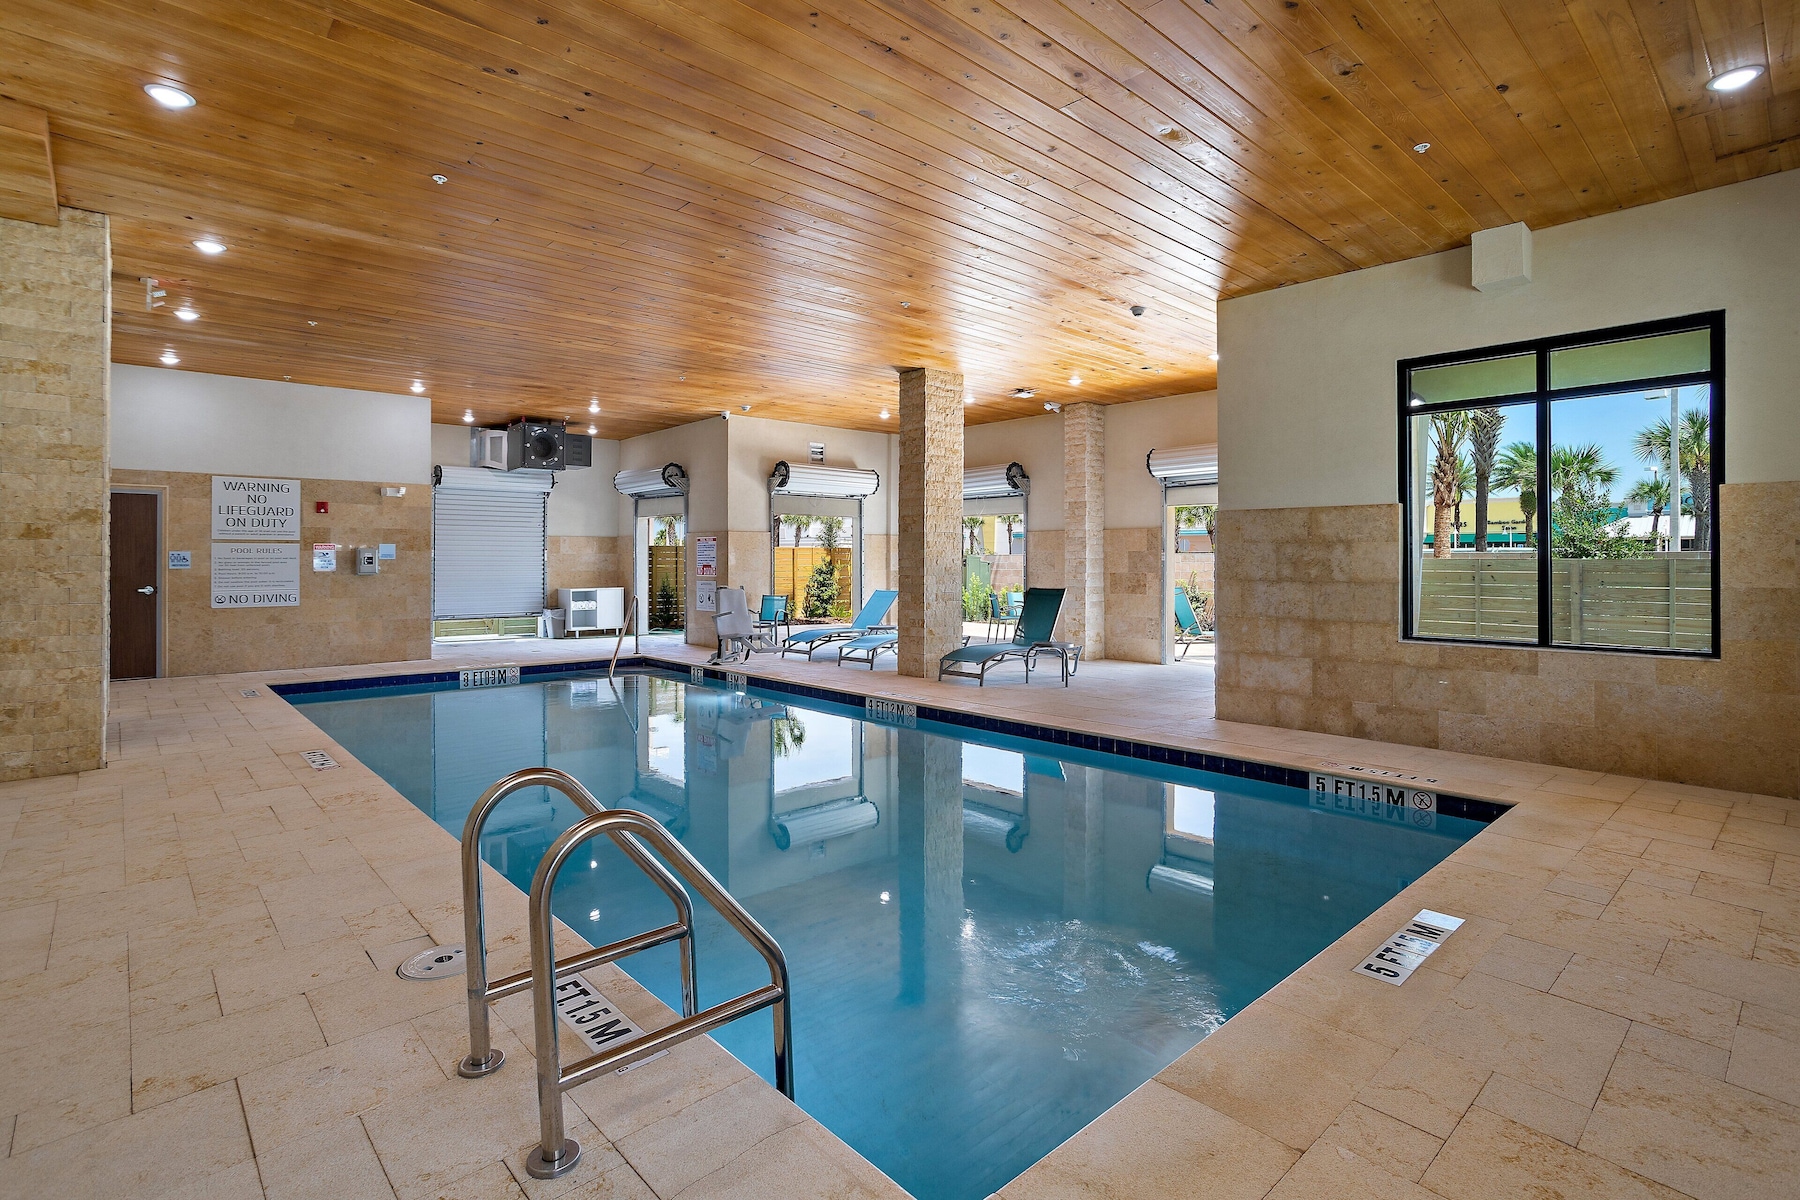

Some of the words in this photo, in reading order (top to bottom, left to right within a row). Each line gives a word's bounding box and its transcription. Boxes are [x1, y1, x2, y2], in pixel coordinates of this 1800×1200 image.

[223, 481, 290, 493] WARNING
[247, 494, 267, 504] NO
[218, 505, 294, 516] LIFEGUARD
[226, 517, 246, 527] ON
[251, 518, 287, 528] DUTY
[229, 594, 249, 604] NO
[253, 593, 297, 604] DIVING
[1316, 776, 1326, 792] 5
[1386, 788, 1405, 807] M
[1363, 963, 1400, 978] 5
[1405, 923, 1444, 940] M
[565, 1000, 612, 1025] 1.5
[585, 1018, 632, 1045] M
